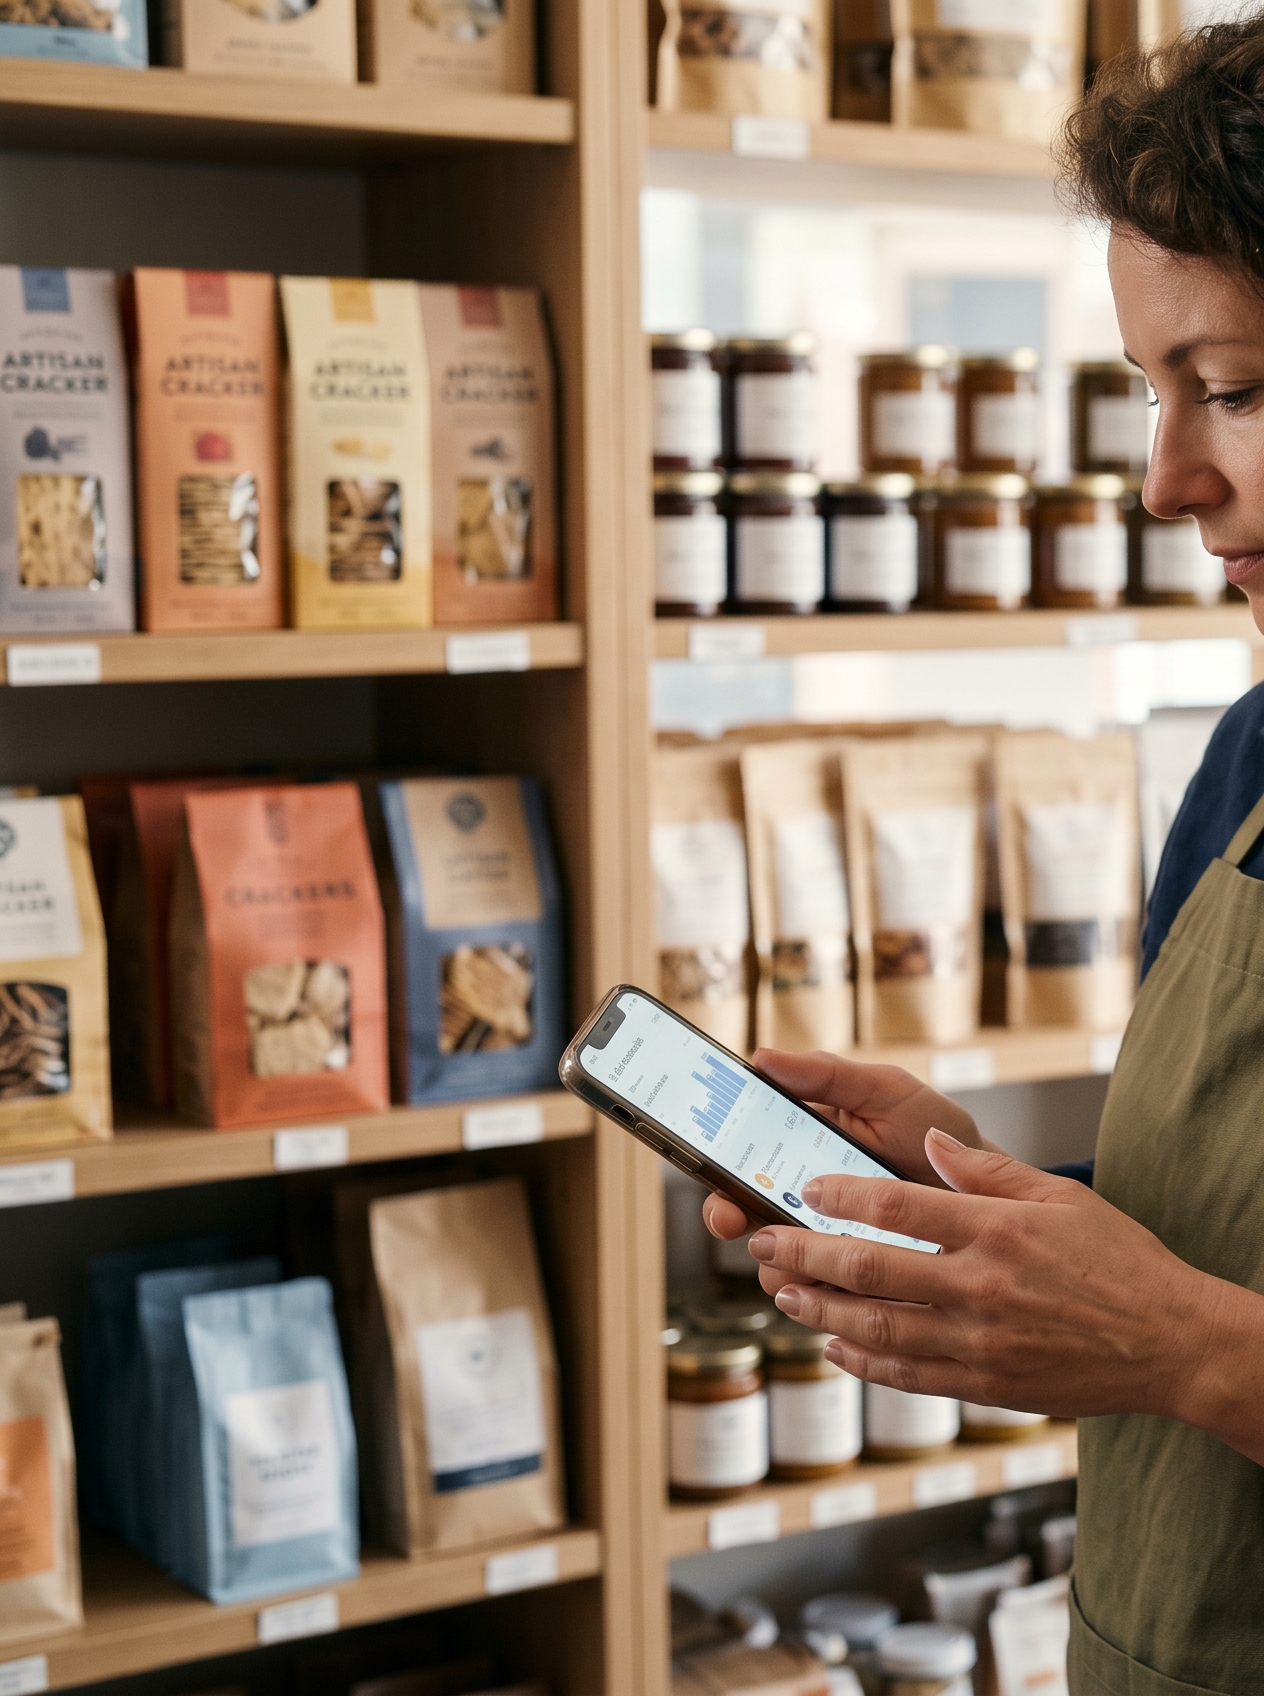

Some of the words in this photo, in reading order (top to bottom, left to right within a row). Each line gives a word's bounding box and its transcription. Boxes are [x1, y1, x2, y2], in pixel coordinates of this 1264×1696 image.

[3, 352, 104, 372] ARTISAN
[165, 356, 260, 375] ARTISAN
[314, 360, 407, 380] ARTISAN
[0, 374, 108, 395] CRACKER
[160, 377, 265, 398] CRACKER
[309, 381, 411, 401] CRACKER
